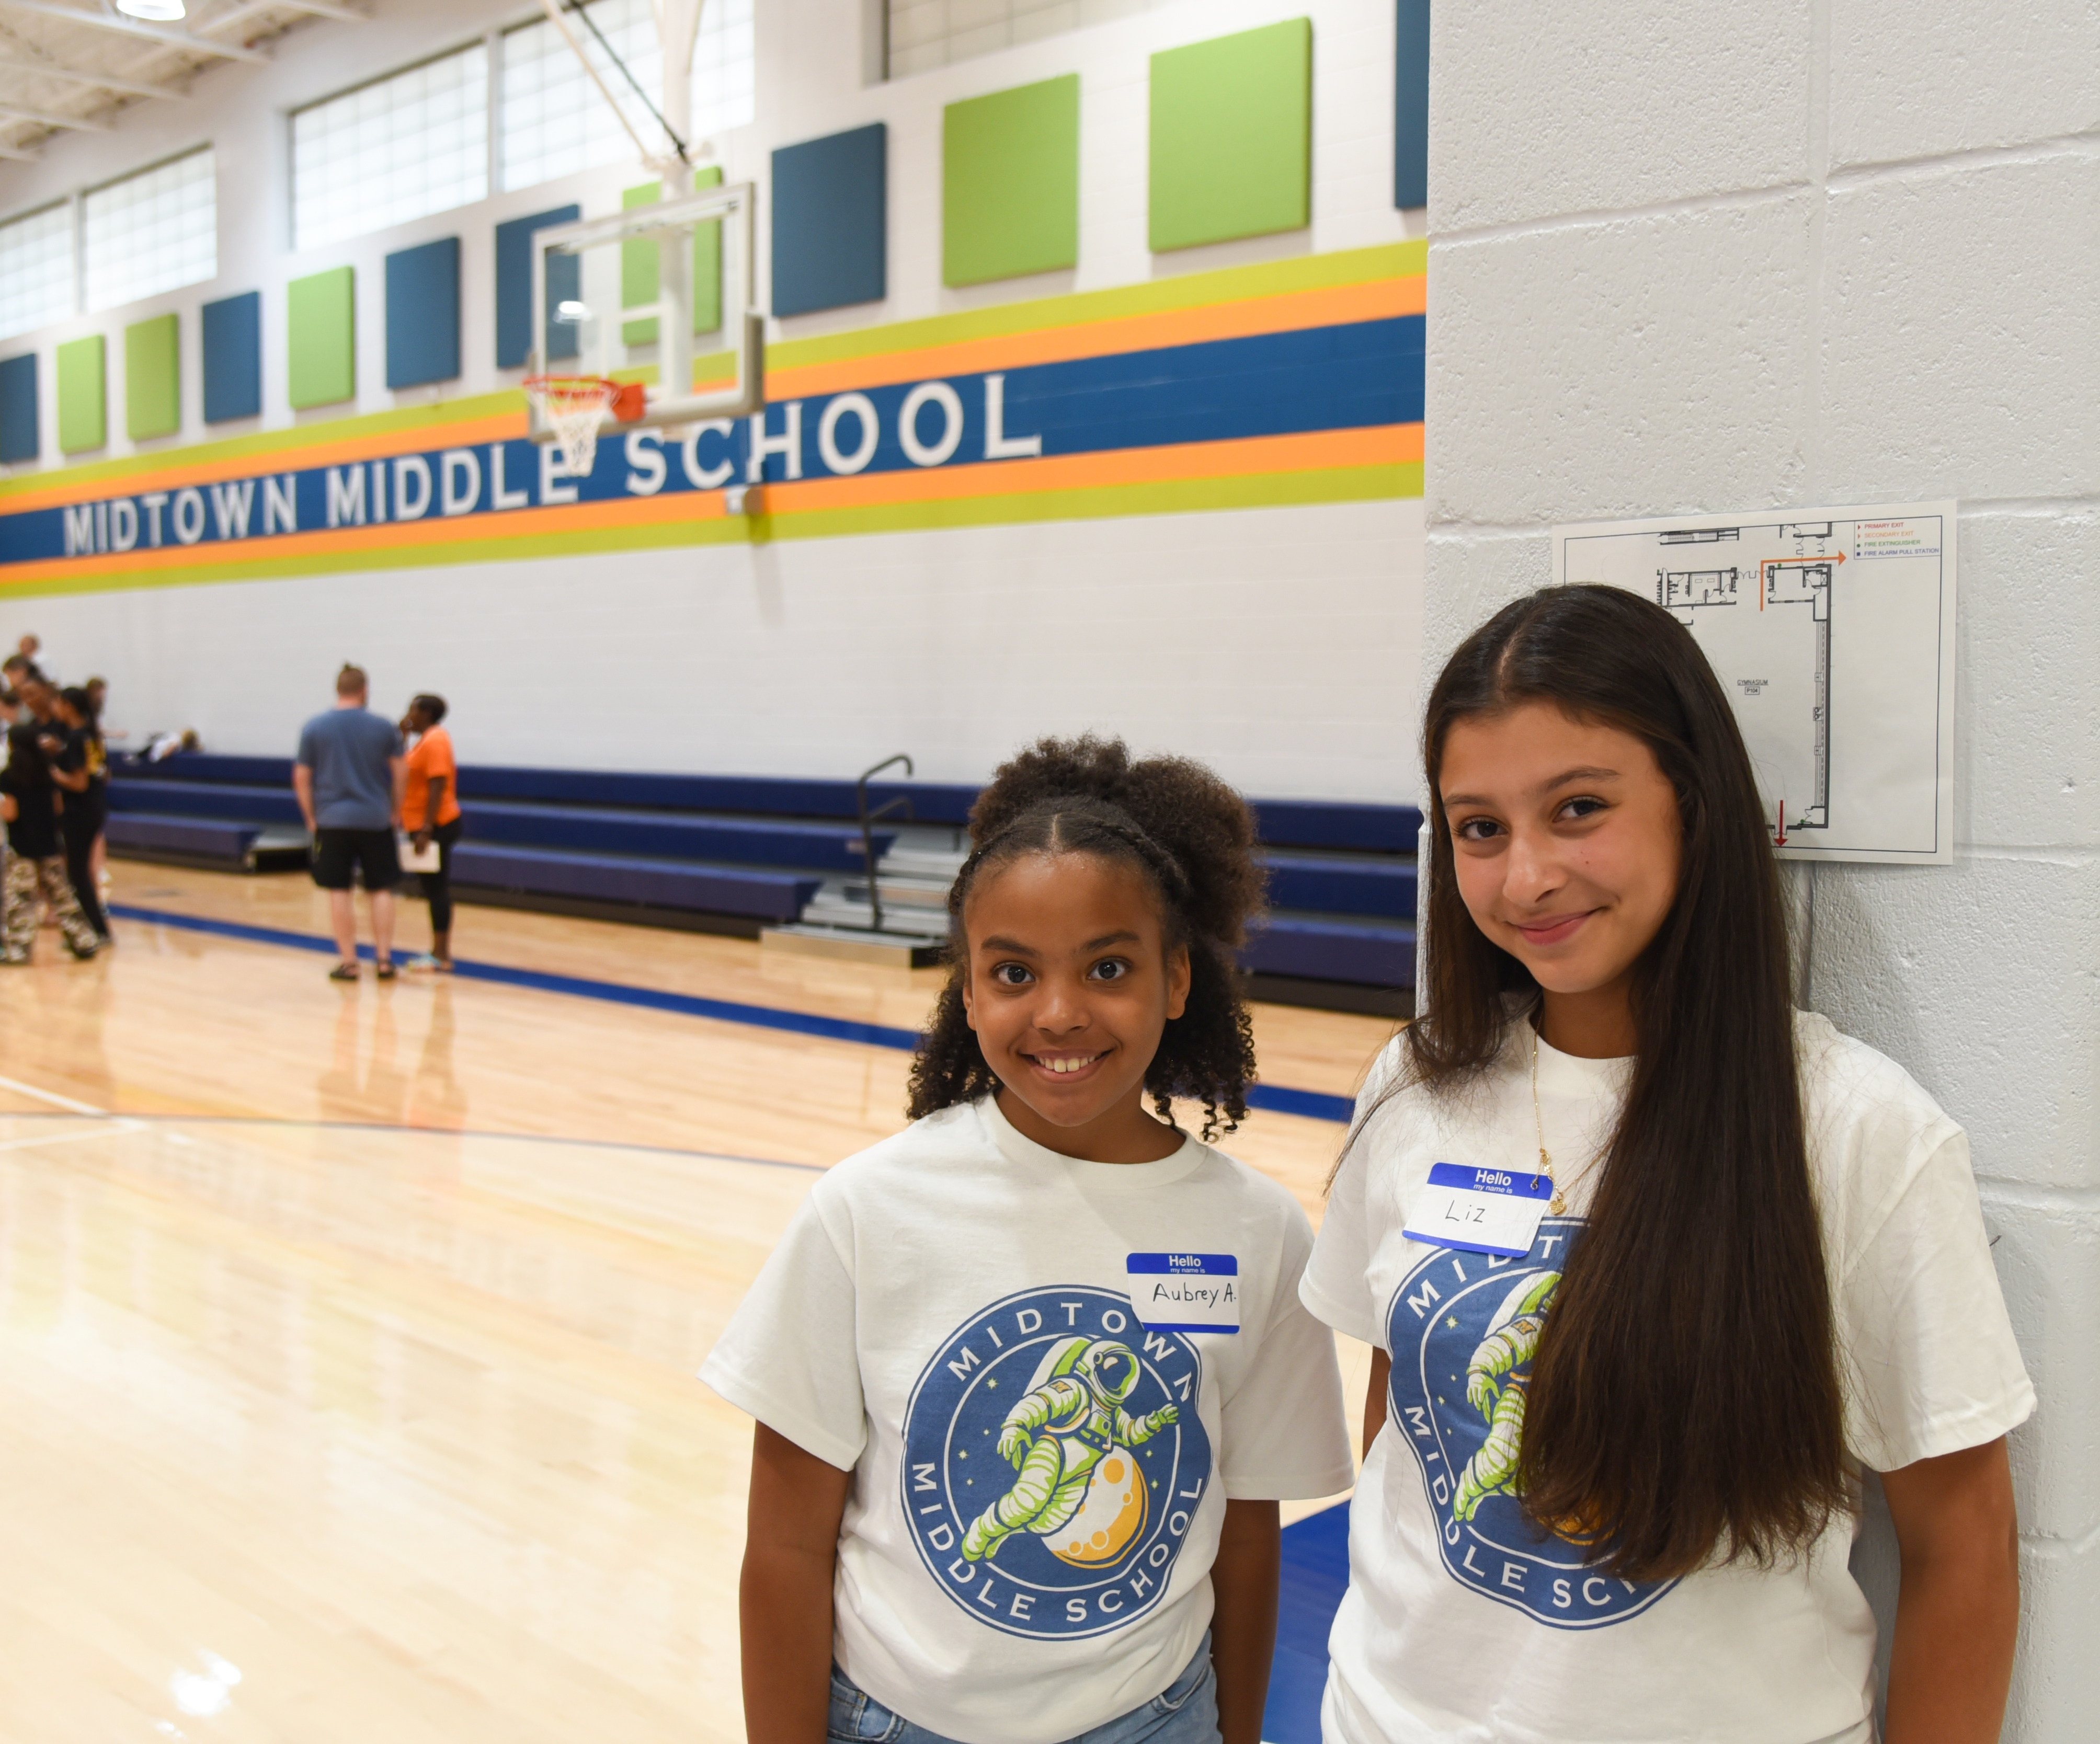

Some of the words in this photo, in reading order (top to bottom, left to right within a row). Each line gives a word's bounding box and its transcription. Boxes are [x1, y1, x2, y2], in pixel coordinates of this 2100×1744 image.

[64, 474, 298, 557] MIDTOWN
[325, 442, 579, 529] MIDDLE
[625, 373, 1042, 496] SCHOOL
[1475, 1169, 1512, 1186] Hello
[1169, 1255, 1202, 1267] Hello
[1152, 1282, 1219, 1309] Aubrey
[1223, 1282, 1237, 1303] A.
[948, 1302, 1192, 1402] MIDTOWN
[912, 1462, 1035, 1621] MIDDLE
[1066, 1477, 1202, 1622] SCHOOL
